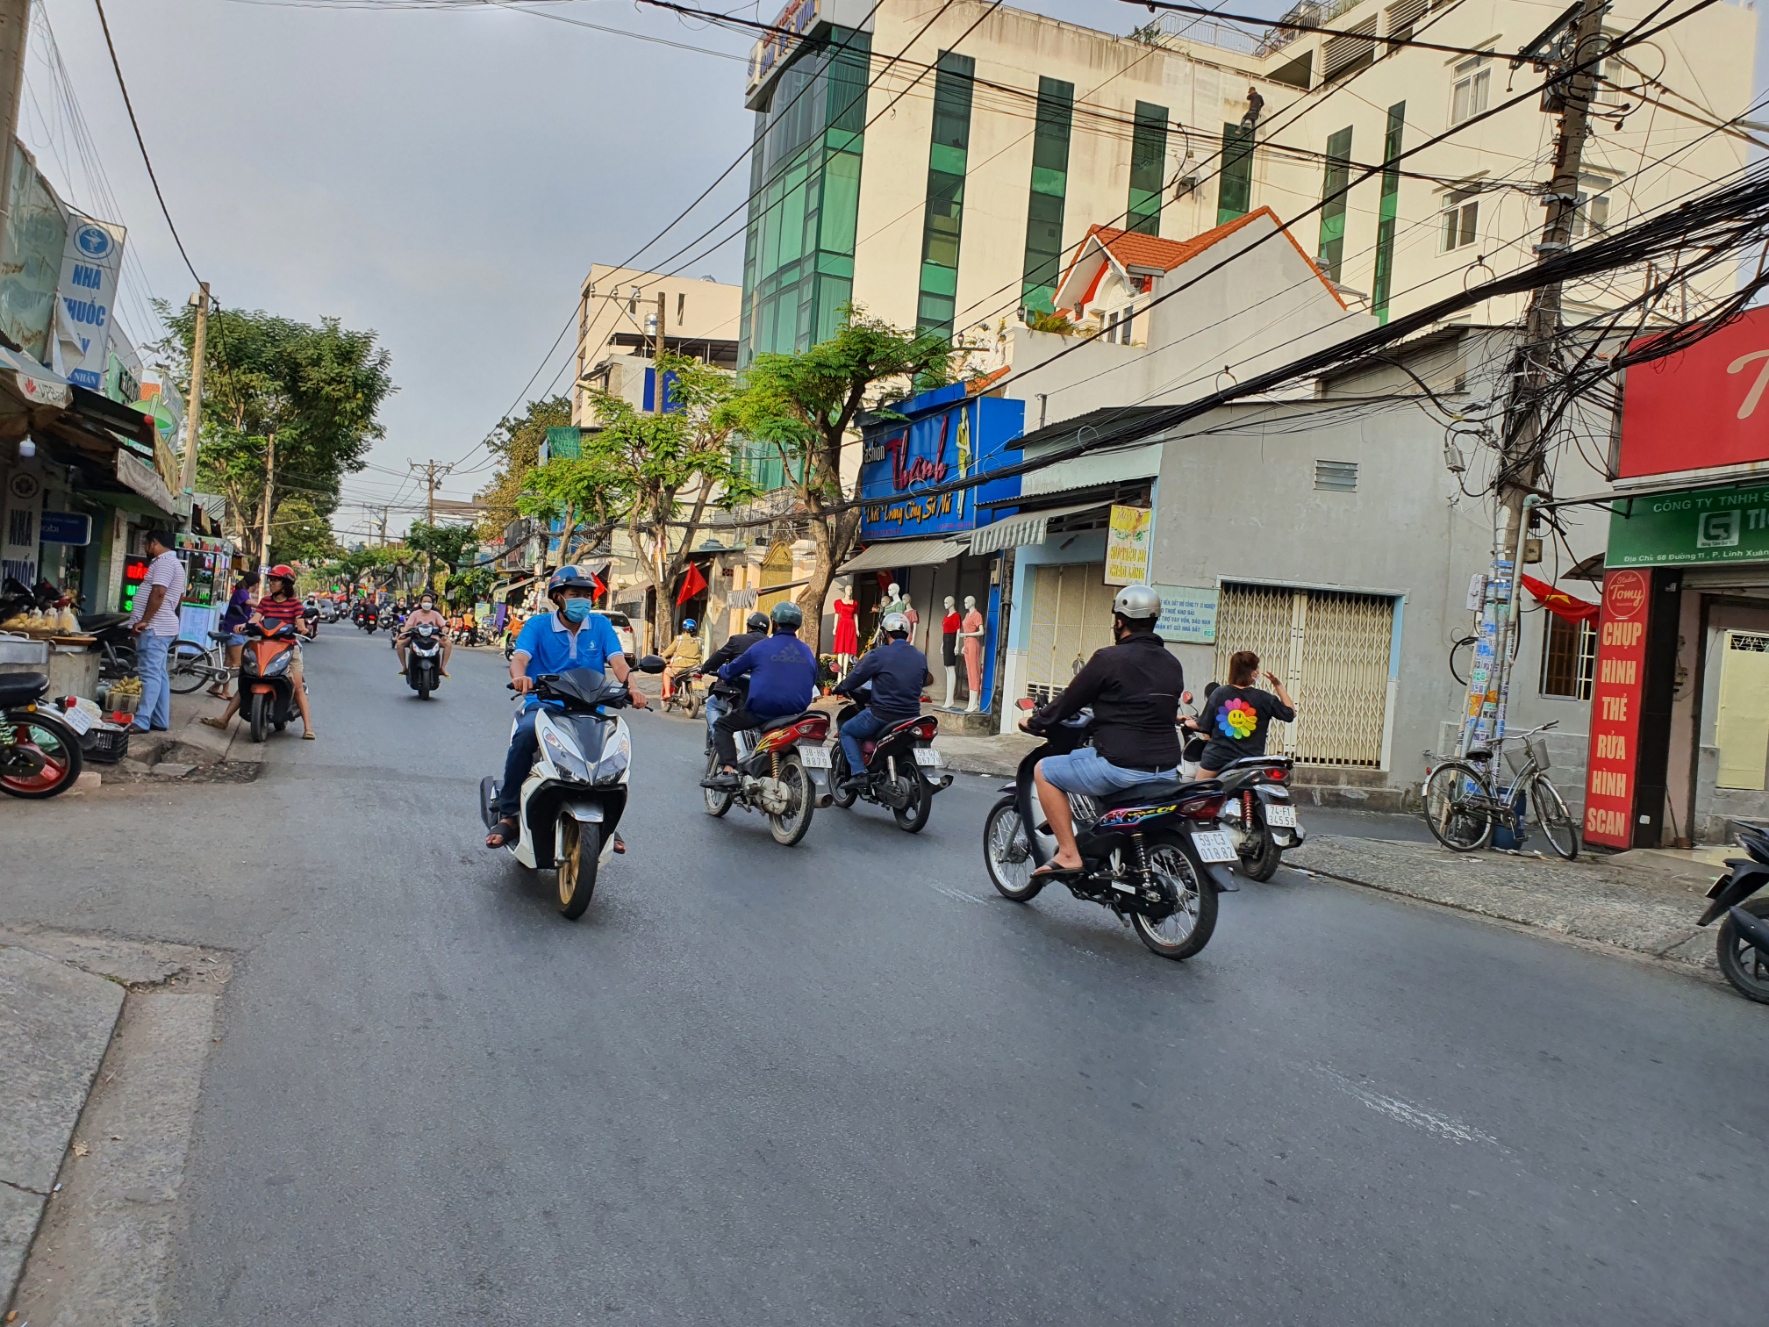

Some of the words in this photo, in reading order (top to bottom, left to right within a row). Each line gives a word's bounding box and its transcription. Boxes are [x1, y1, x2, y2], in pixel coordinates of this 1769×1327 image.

[63, 296, 106, 326] HUỐC
[1653, 499, 1692, 513] CÔNG
[1696, 497, 1713, 508] TY
[1719, 493, 1758, 506] TNHH
[1610, 584, 1645, 607] Tomy
[1603, 622, 1642, 649] CHỤP
[1600, 656, 1637, 685] HÌNH
[1601, 693, 1627, 722] THẺ
[1596, 730, 1626, 760] RỬA
[1592, 766, 1627, 798] HÌNH
[1270, 806, 1291, 816] 74-F1
[1587, 807, 1626, 837] SCAN
[1198, 833, 1226, 846] 59-C3
